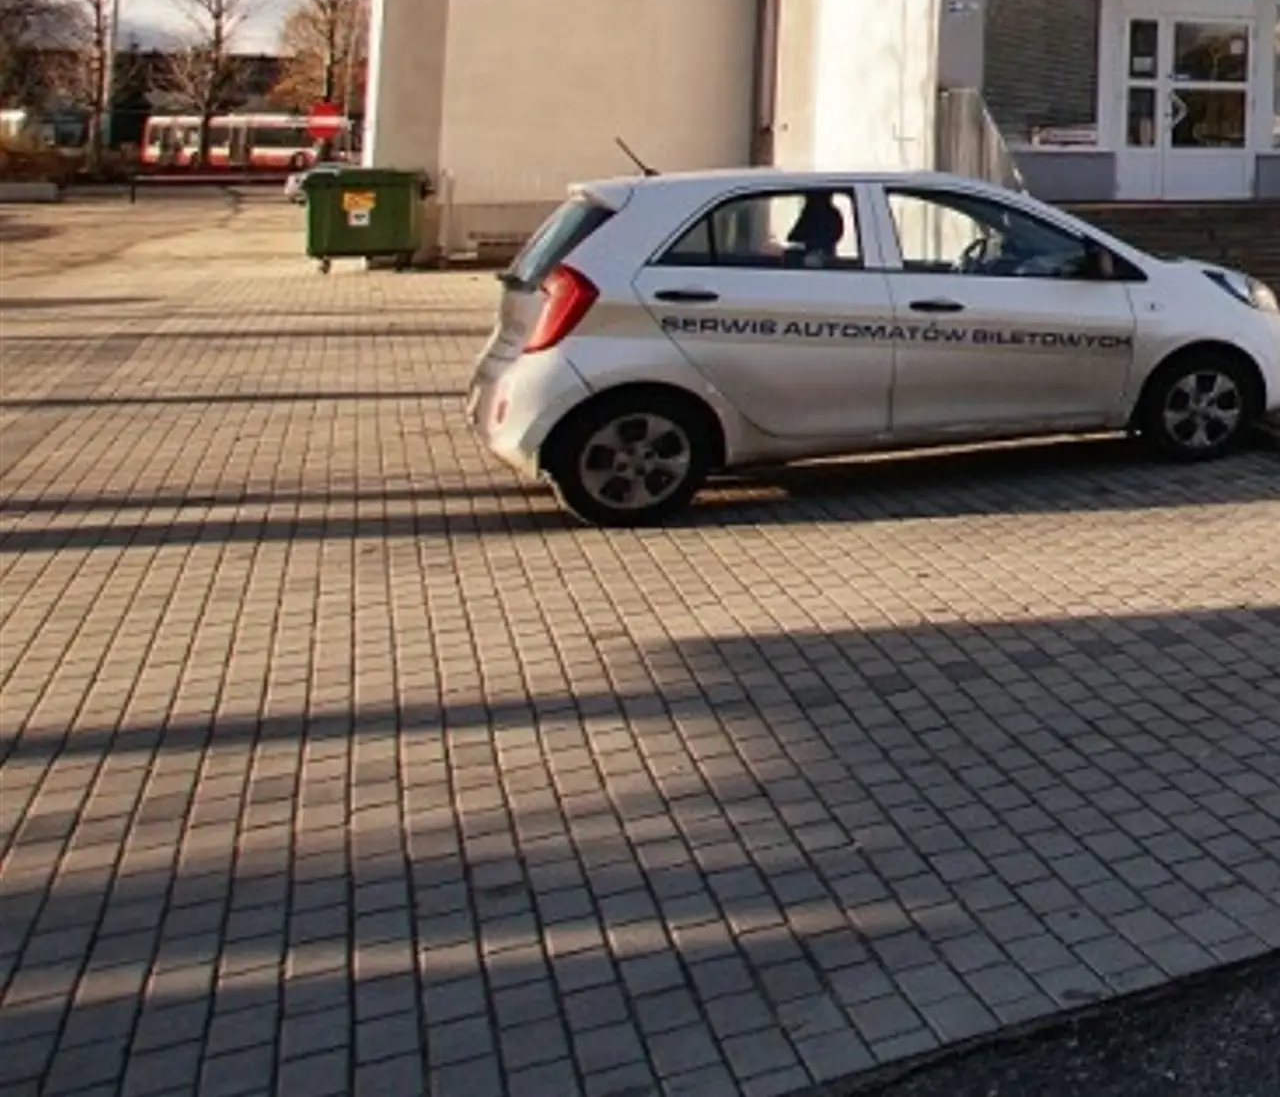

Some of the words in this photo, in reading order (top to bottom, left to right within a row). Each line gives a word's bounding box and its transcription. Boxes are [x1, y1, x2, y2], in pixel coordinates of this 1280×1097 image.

[661, 315, 778, 336] SERWIS
[782, 320, 968, 342] AUTOMATÓW
[972, 328, 1134, 349] BILETOWYCH
